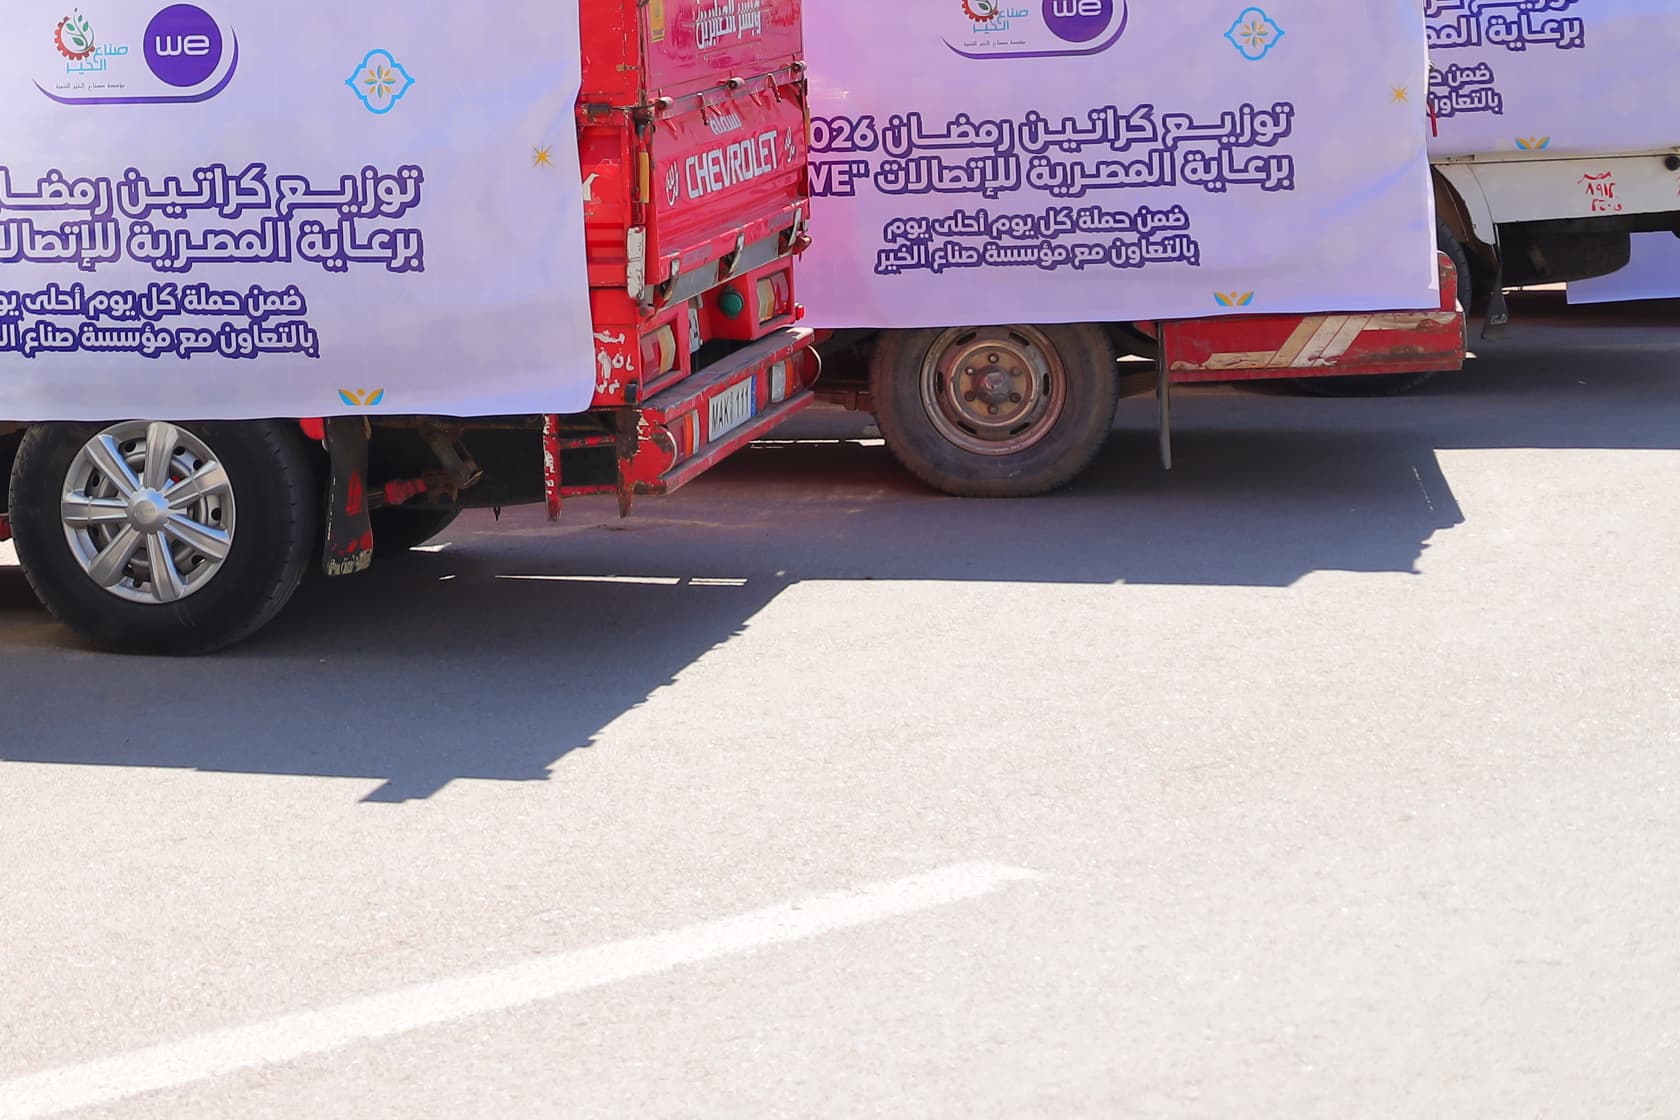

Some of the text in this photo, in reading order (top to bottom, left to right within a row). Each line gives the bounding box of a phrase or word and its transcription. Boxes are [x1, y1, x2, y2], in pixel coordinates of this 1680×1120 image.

[997, 7, 1029, 25] صناع
[1486, 11, 1584, 50] برعاية
[94, 44, 128, 64] صناع
[155, 34, 210, 56] we
[66, 59, 106, 74] الخير
[1446, 62, 1495, 90] ضمن
[809, 116, 879, 153] 026
[883, 112, 1014, 157] رمضان
[1020, 104, 1157, 153] كراتين
[1162, 103, 1294, 147] توزيع
[685, 130, 778, 200] CHEVROLET
[874, 154, 1020, 199] للإتصالات
[1027, 148, 1175, 198] المصرية
[1181, 145, 1294, 193] برعاية
[120, 164, 270, 216] كراتين
[275, 166, 423, 216] توزيع
[884, 205, 1190, 242] ضمن حملة كل يوم أحلى يوم
[126, 217, 291, 271] المصرية
[297, 216, 424, 271] برعاية
[875, 234, 1200, 273] بالتعاون مع مؤسسة صناع الخير
[23, 283, 83, 317] أحلى
[87, 290, 136, 321] يوم
[139, 282, 179, 318] كل
[181, 283, 241, 315] حملة
[245, 284, 306, 319] ضمن
[22, 321, 77, 359] صناع
[79, 321, 174, 358] مؤسسة
[177, 326, 216, 359] مع
[219, 321, 319, 358] بالتعاون
